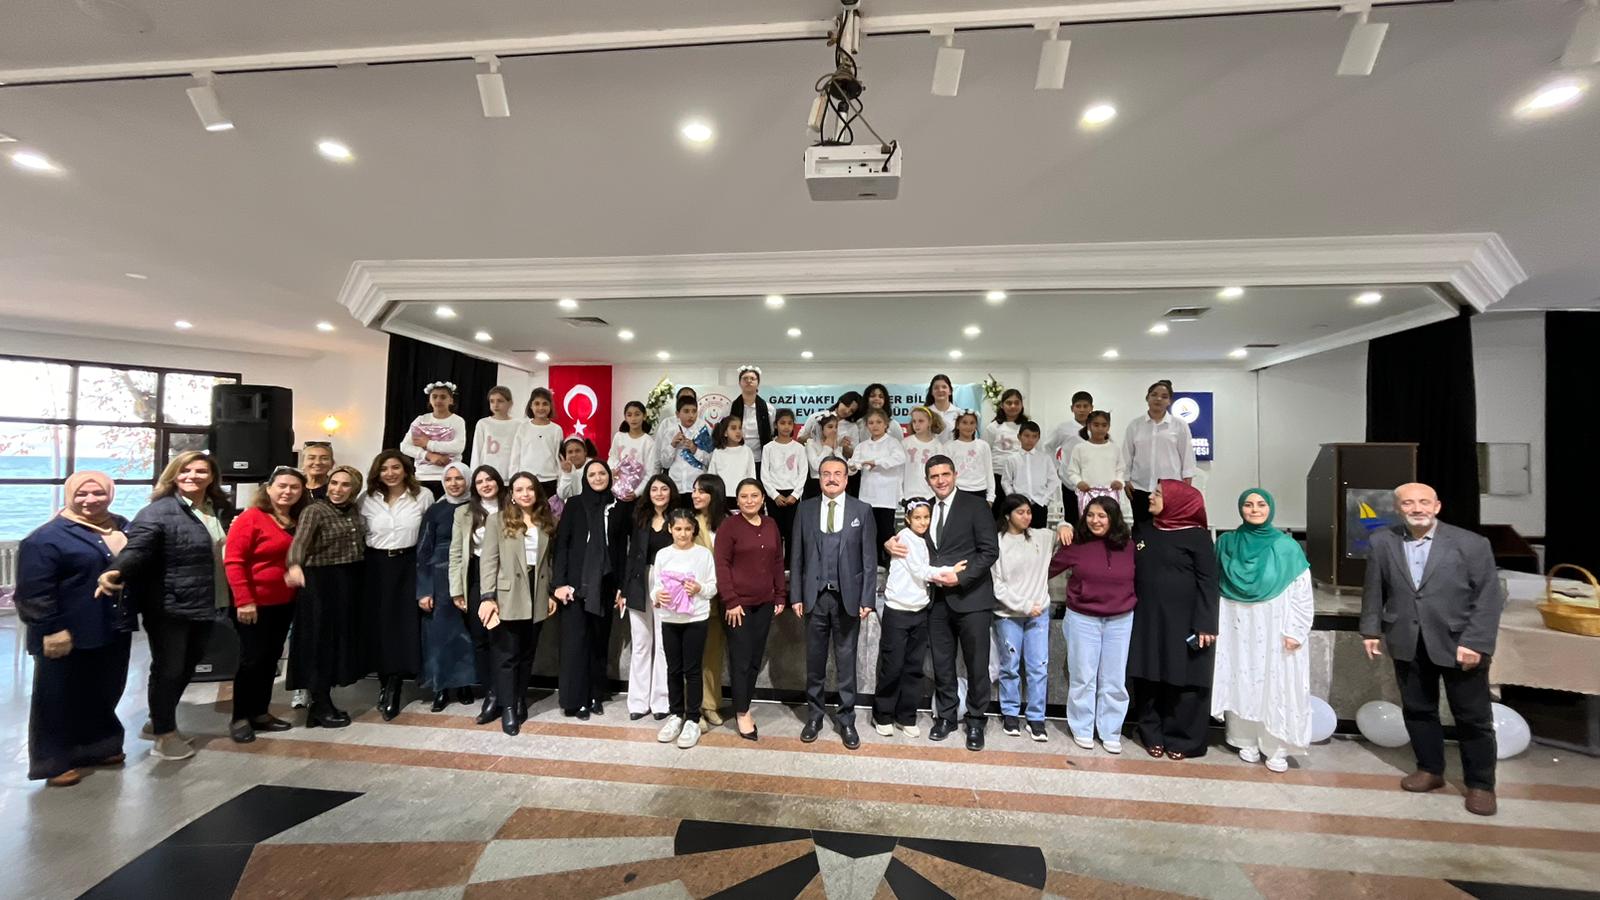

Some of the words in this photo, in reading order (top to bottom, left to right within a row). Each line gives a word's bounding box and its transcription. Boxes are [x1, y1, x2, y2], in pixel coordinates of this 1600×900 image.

[769, 394, 796, 404] GAZİ
[800, 396, 835, 404] VAKFI
[906, 393, 925, 404] BİL
